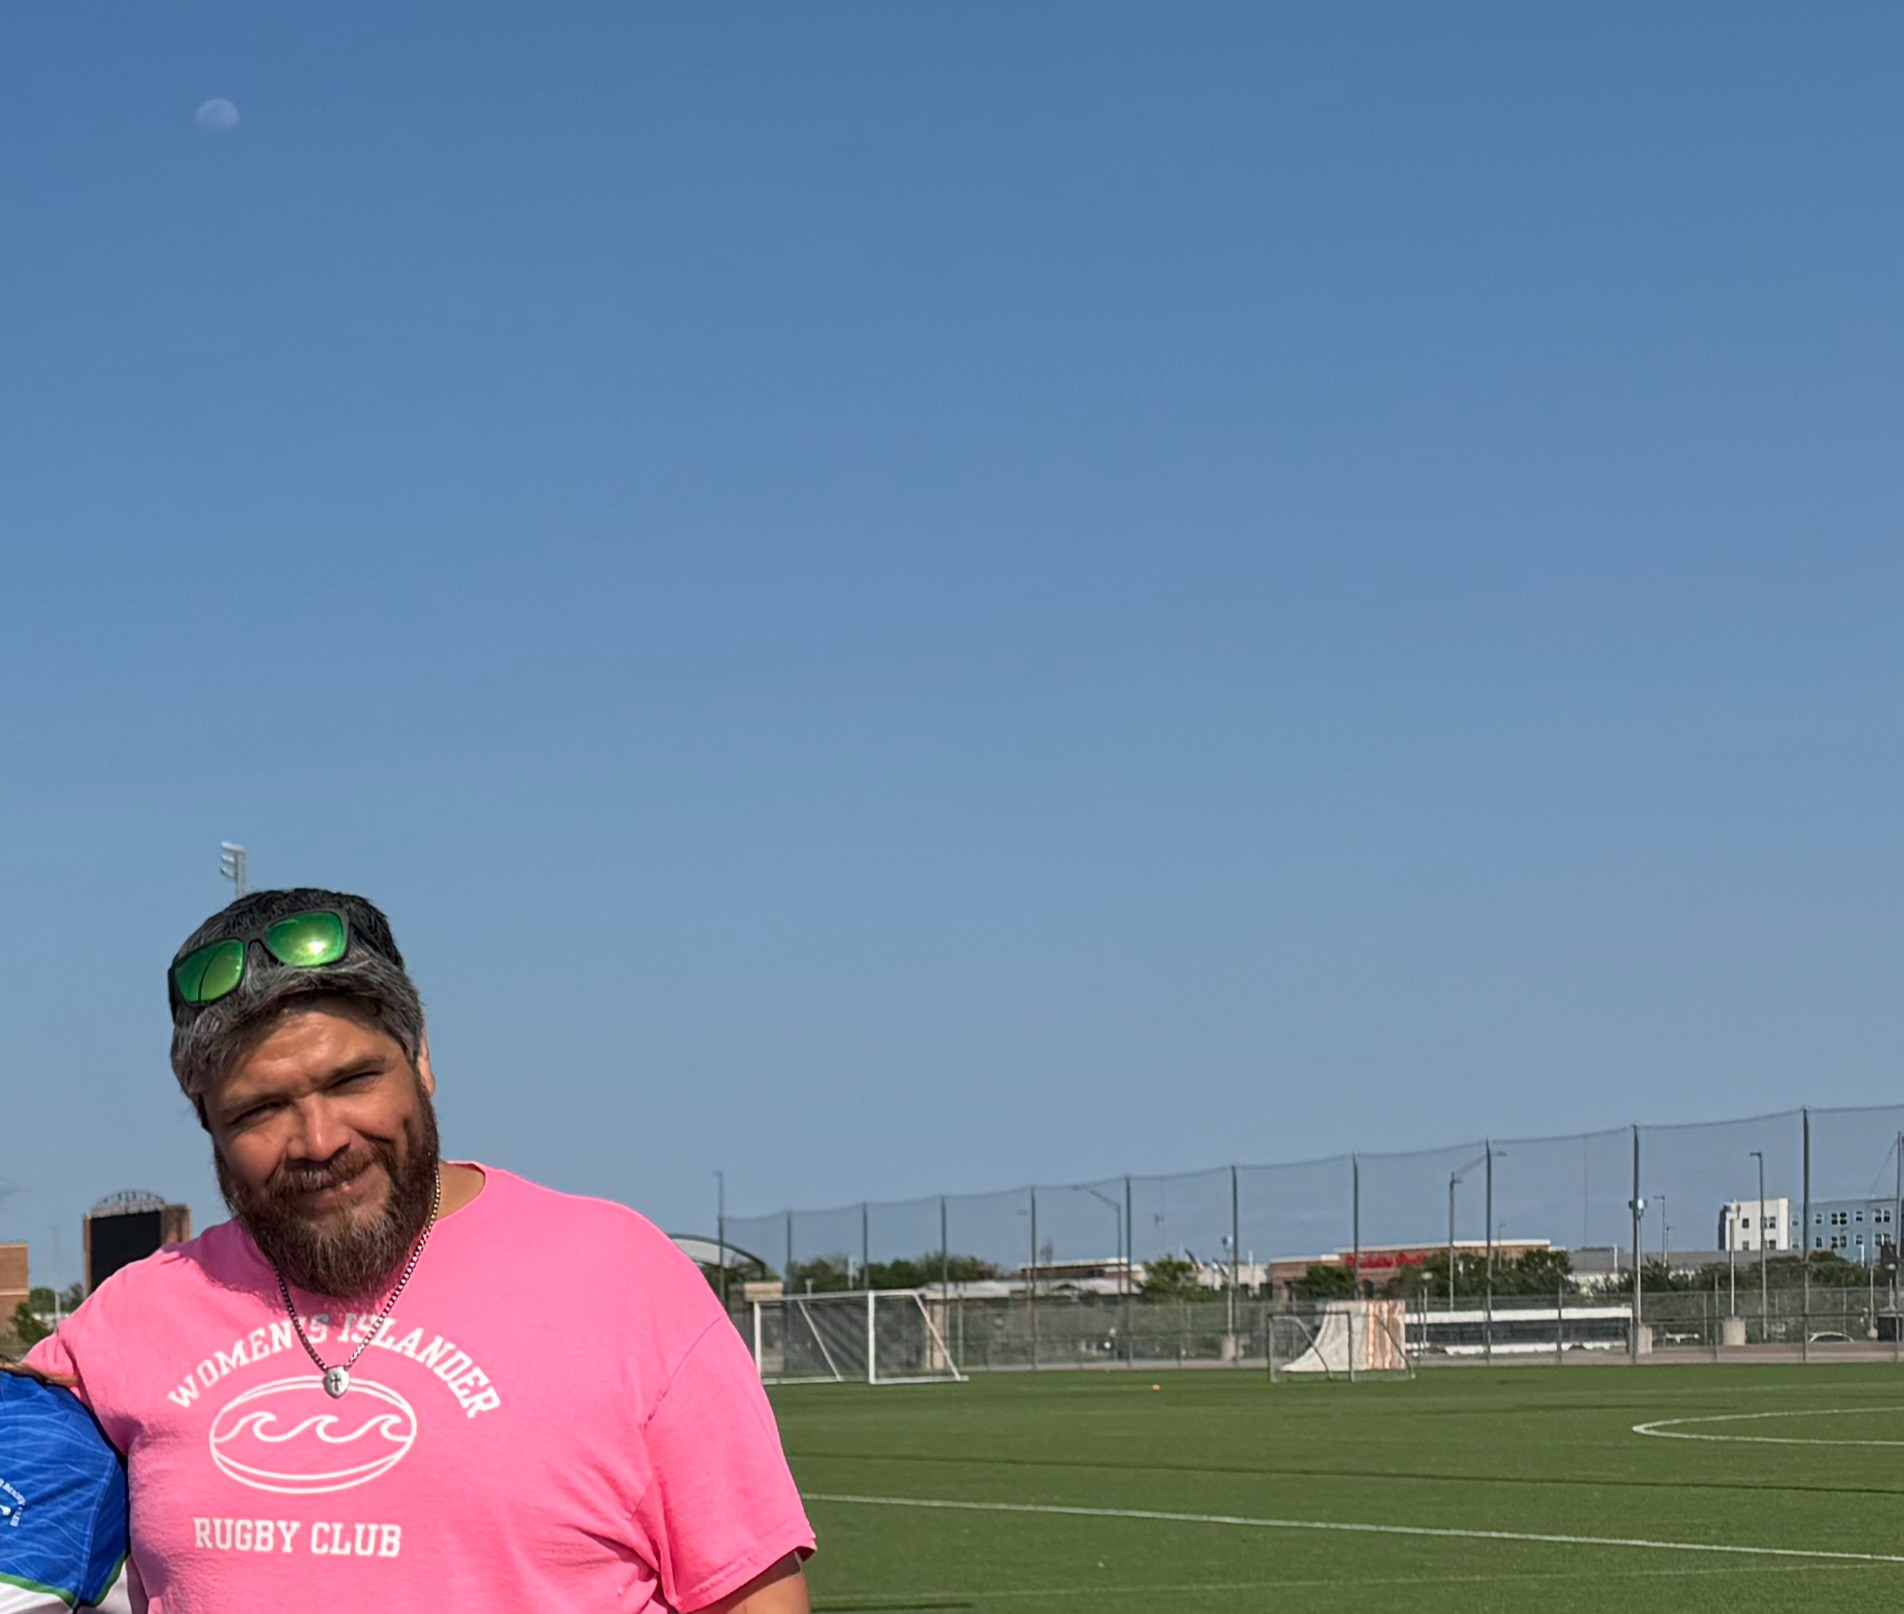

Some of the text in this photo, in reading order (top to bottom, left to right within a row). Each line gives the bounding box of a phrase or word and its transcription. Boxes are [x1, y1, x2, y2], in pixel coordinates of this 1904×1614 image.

[167, 1314, 501, 1418] WOMEN'S ISLANDER
[193, 1516, 402, 1558] RUGBY CLUB
